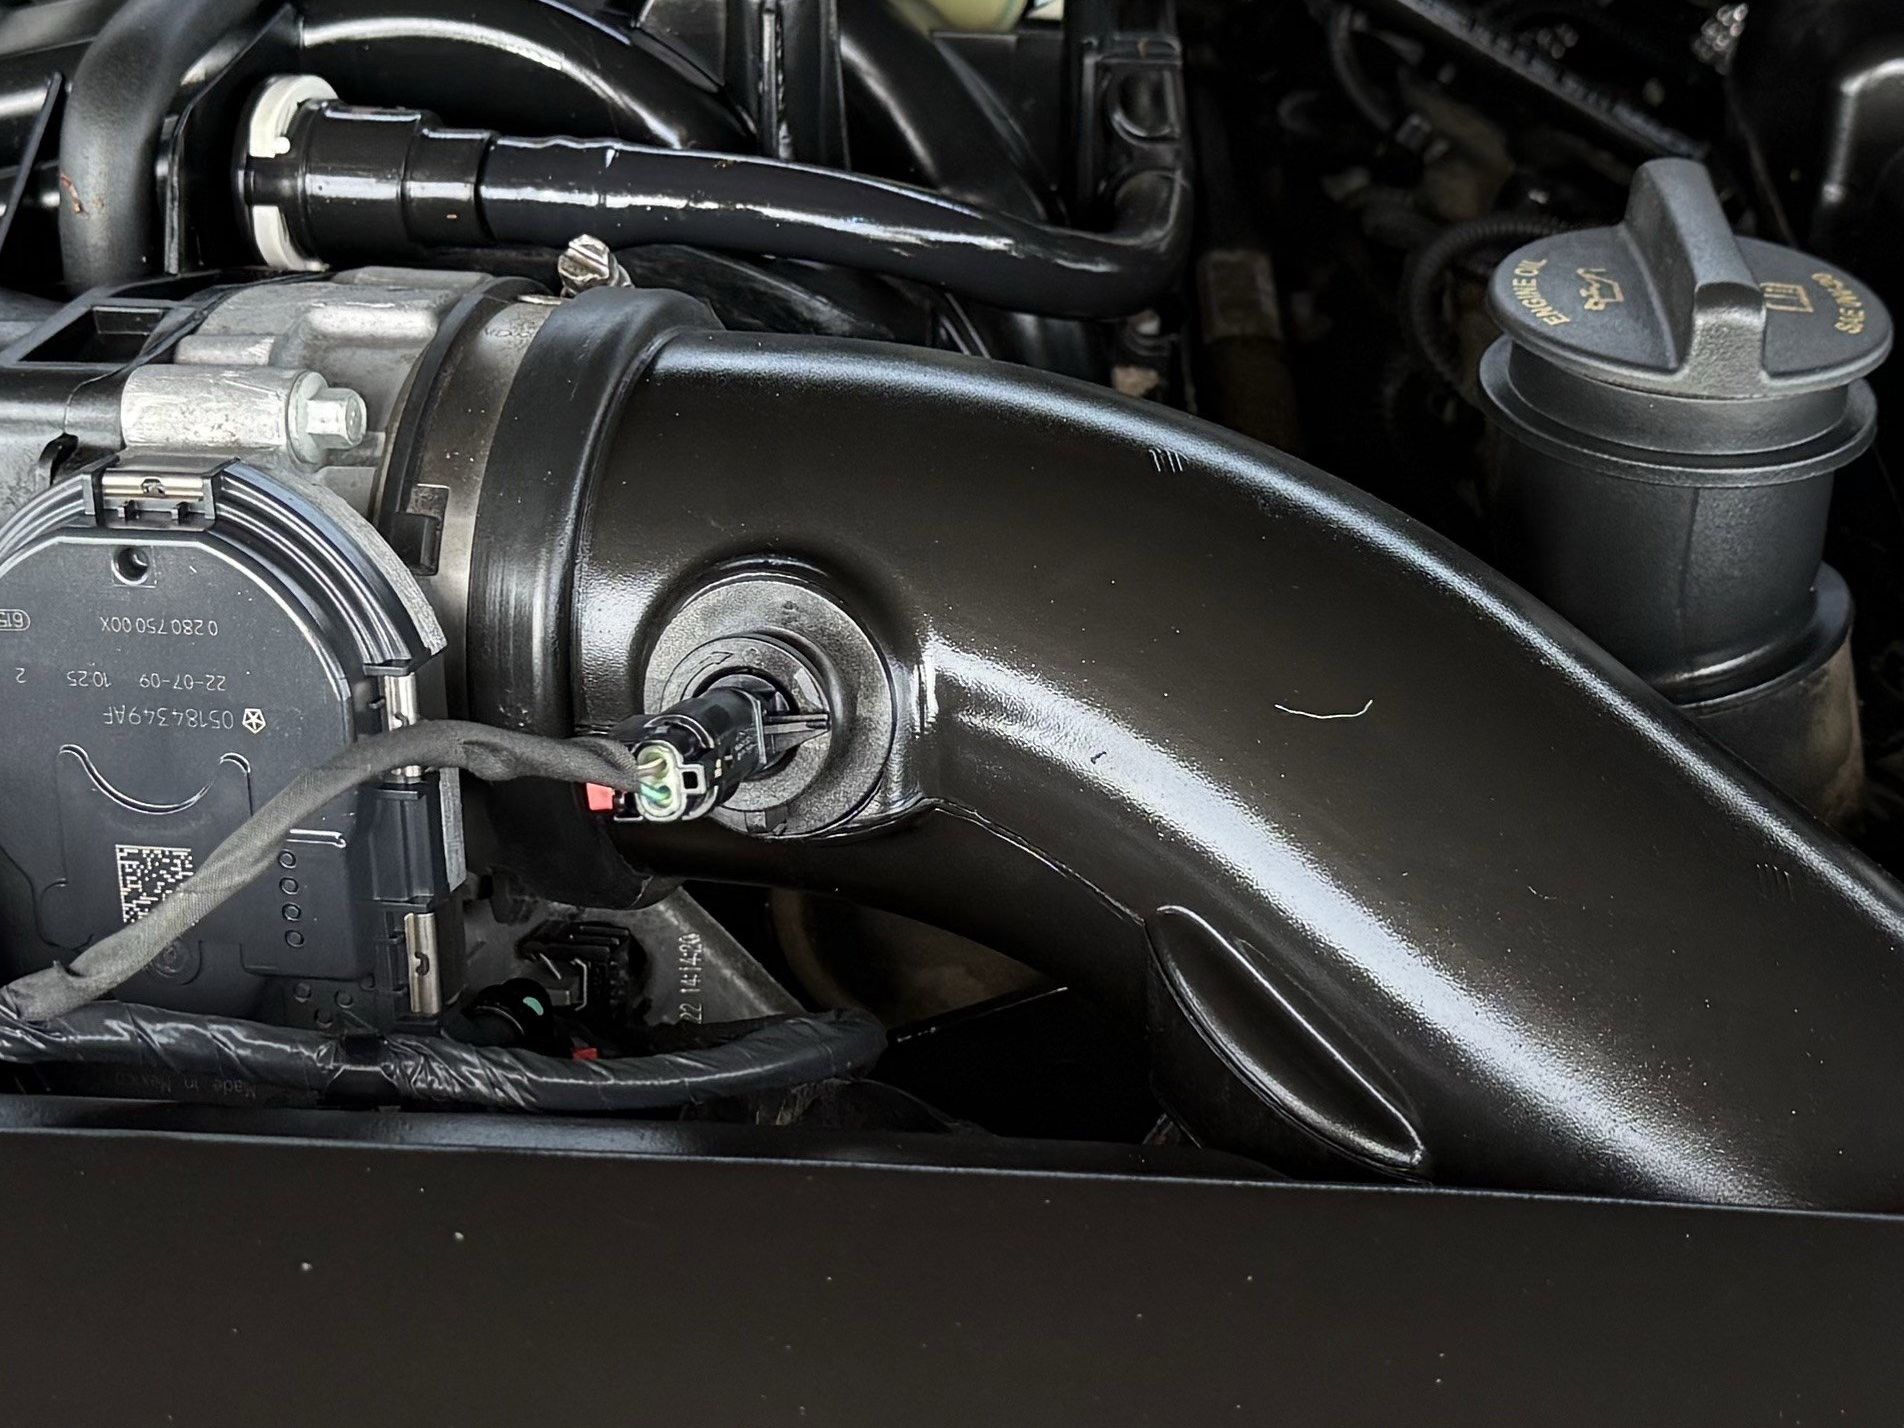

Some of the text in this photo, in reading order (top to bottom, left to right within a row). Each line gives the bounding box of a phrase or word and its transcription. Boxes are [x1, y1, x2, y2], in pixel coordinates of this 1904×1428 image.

[1512, 257, 1571, 327] ENGINE OIL
[15, 667, 27, 684] 2
[138, 672, 227, 692] 22-07-09
[101, 703, 235, 730] 05184349AF
